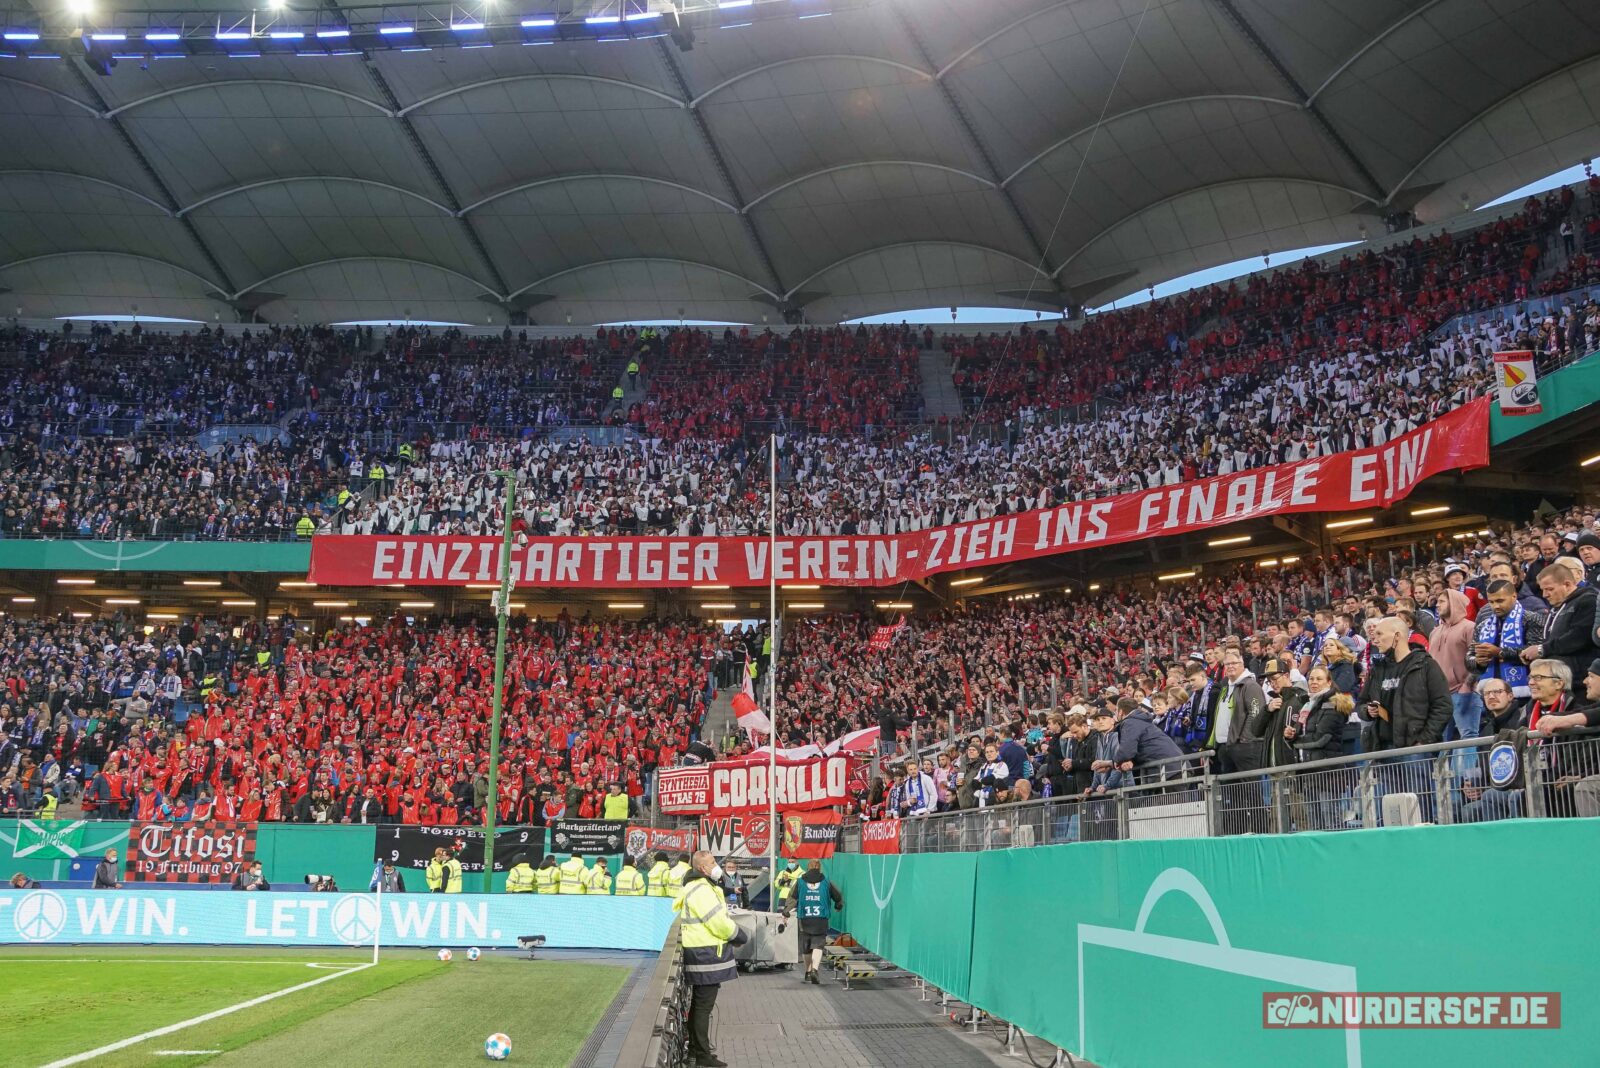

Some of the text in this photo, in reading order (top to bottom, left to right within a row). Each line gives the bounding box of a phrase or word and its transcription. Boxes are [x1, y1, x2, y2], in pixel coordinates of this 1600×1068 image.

[372, 540, 719, 583] EINZIGARTIGER
[1034, 501, 1114, 551] INS
[1137, 462, 1320, 534] FINALE
[659, 776, 708, 792] SYNTHESIA
[713, 757, 847, 808] CORRILLO
[661, 793, 693, 806] ULTRAS
[140, 825, 246, 858] Tifosi
[394, 827, 400, 839] 1
[138, 860, 242, 877] 19 Freiburg 97
[76, 897, 189, 936] WIN.
[245, 899, 502, 939] LET WIN.
[804, 906, 821, 917] 13
